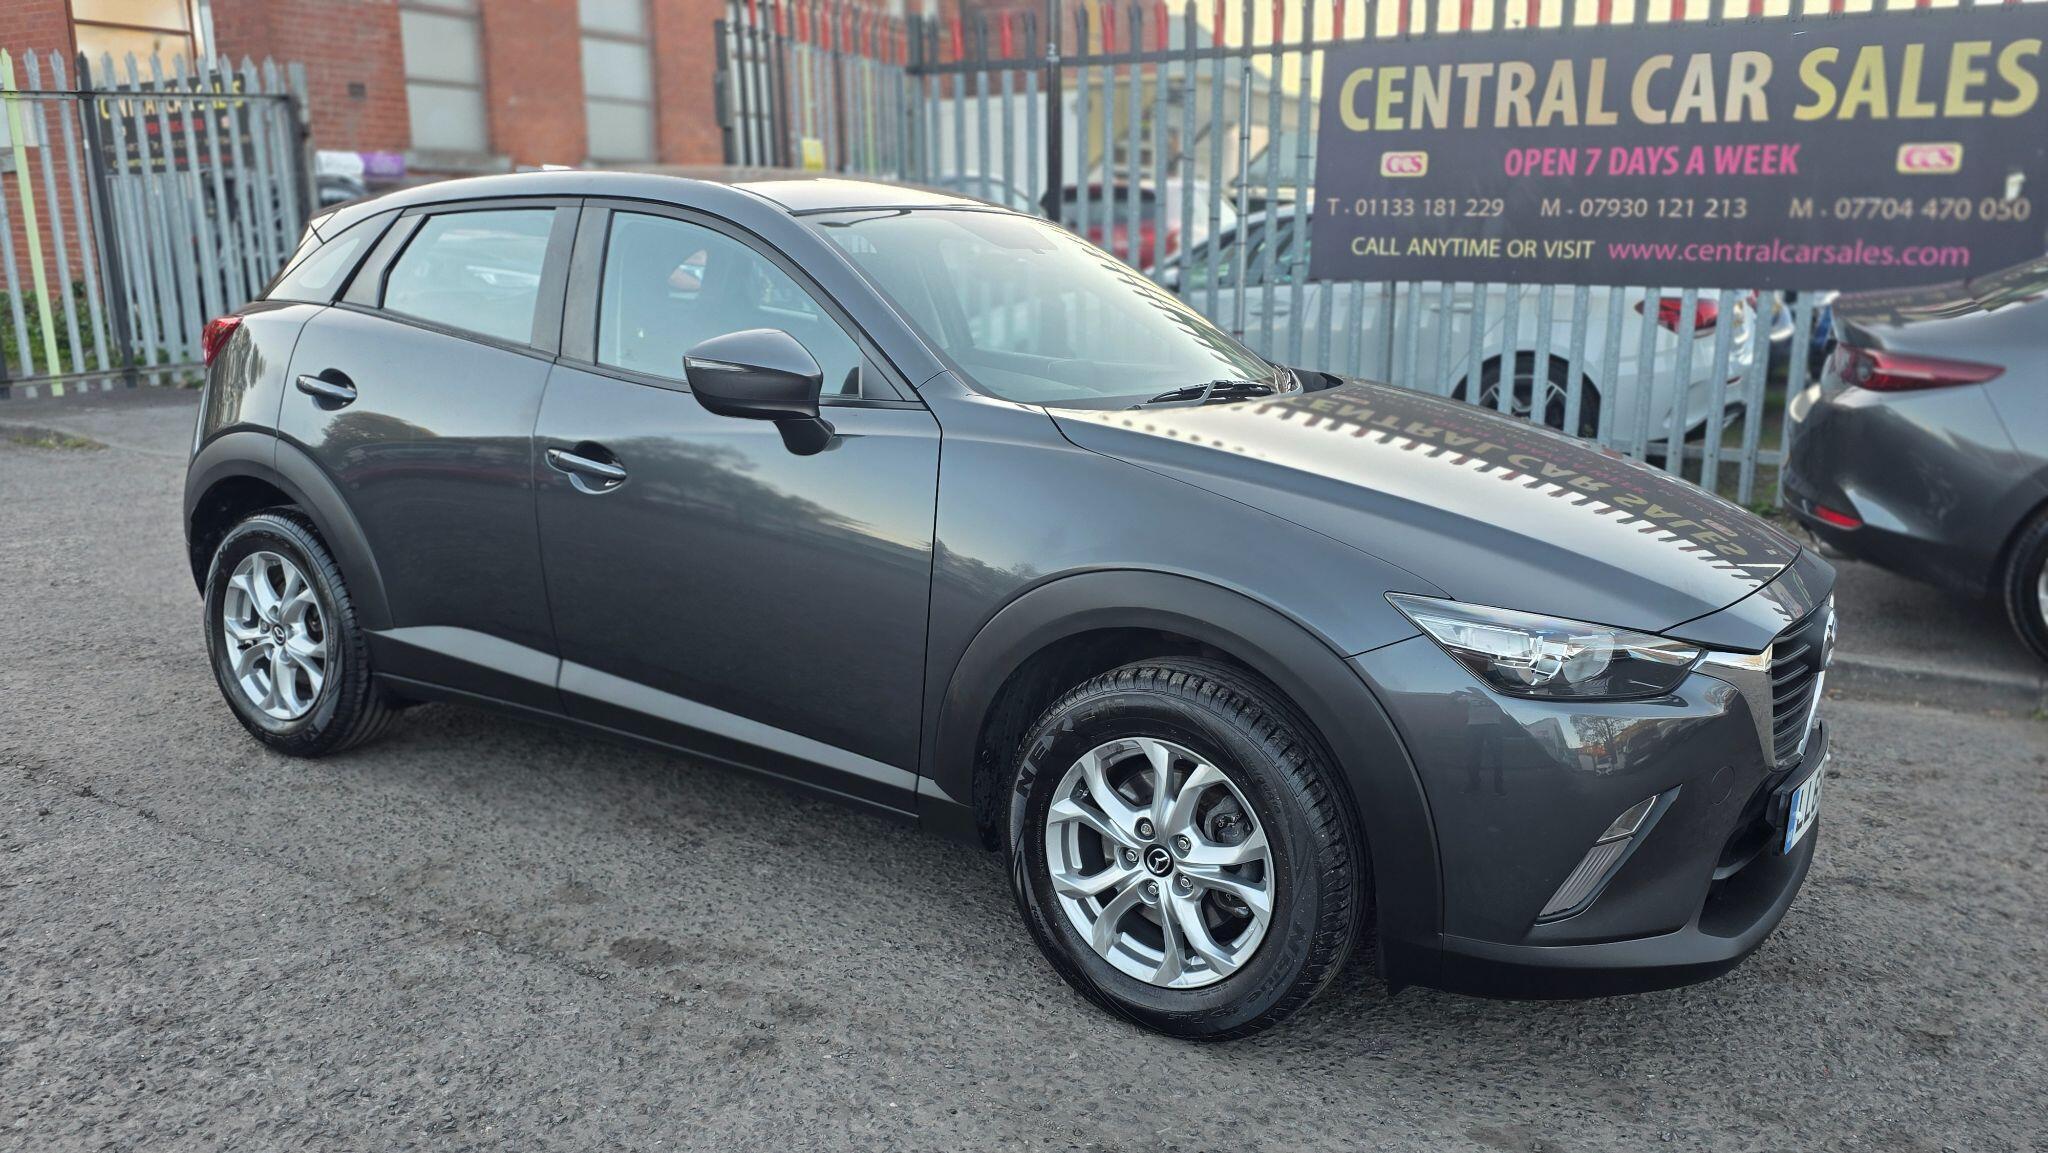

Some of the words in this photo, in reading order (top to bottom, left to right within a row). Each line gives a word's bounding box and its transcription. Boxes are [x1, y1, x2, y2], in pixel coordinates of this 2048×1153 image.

[1339, 58, 1619, 132] CENTRAL
[1631, 51, 1773, 124] CAR
[1793, 38, 2043, 121] SALES
[1386, 154, 1423, 174] CCS
[1504, 147, 1577, 177] OPEN
[1585, 148, 1602, 176] 7
[1608, 146, 1679, 176] DAYS
[1684, 145, 1705, 175] A
[1714, 144, 1800, 175] WEEK
[1355, 198, 1415, 217] 01133
[1423, 198, 1457, 217] 181
[1464, 198, 1504, 217] 229
[1579, 198, 1648, 218] 07930
[1657, 198, 1695, 218] 121
[1704, 198, 1748, 218] 213
[1834, 198, 1914, 220] 07704
[1921, 198, 1972, 220] 470
[1979, 198, 2031, 220] 050
[1351, 237, 1400, 256] CALL
[1407, 237, 1500, 258] ANYTIME
[1507, 238, 1537, 258] OR
[1543, 240, 1595, 259] VISIT
[1608, 238, 1970, 267] www.centralcarsales.com
